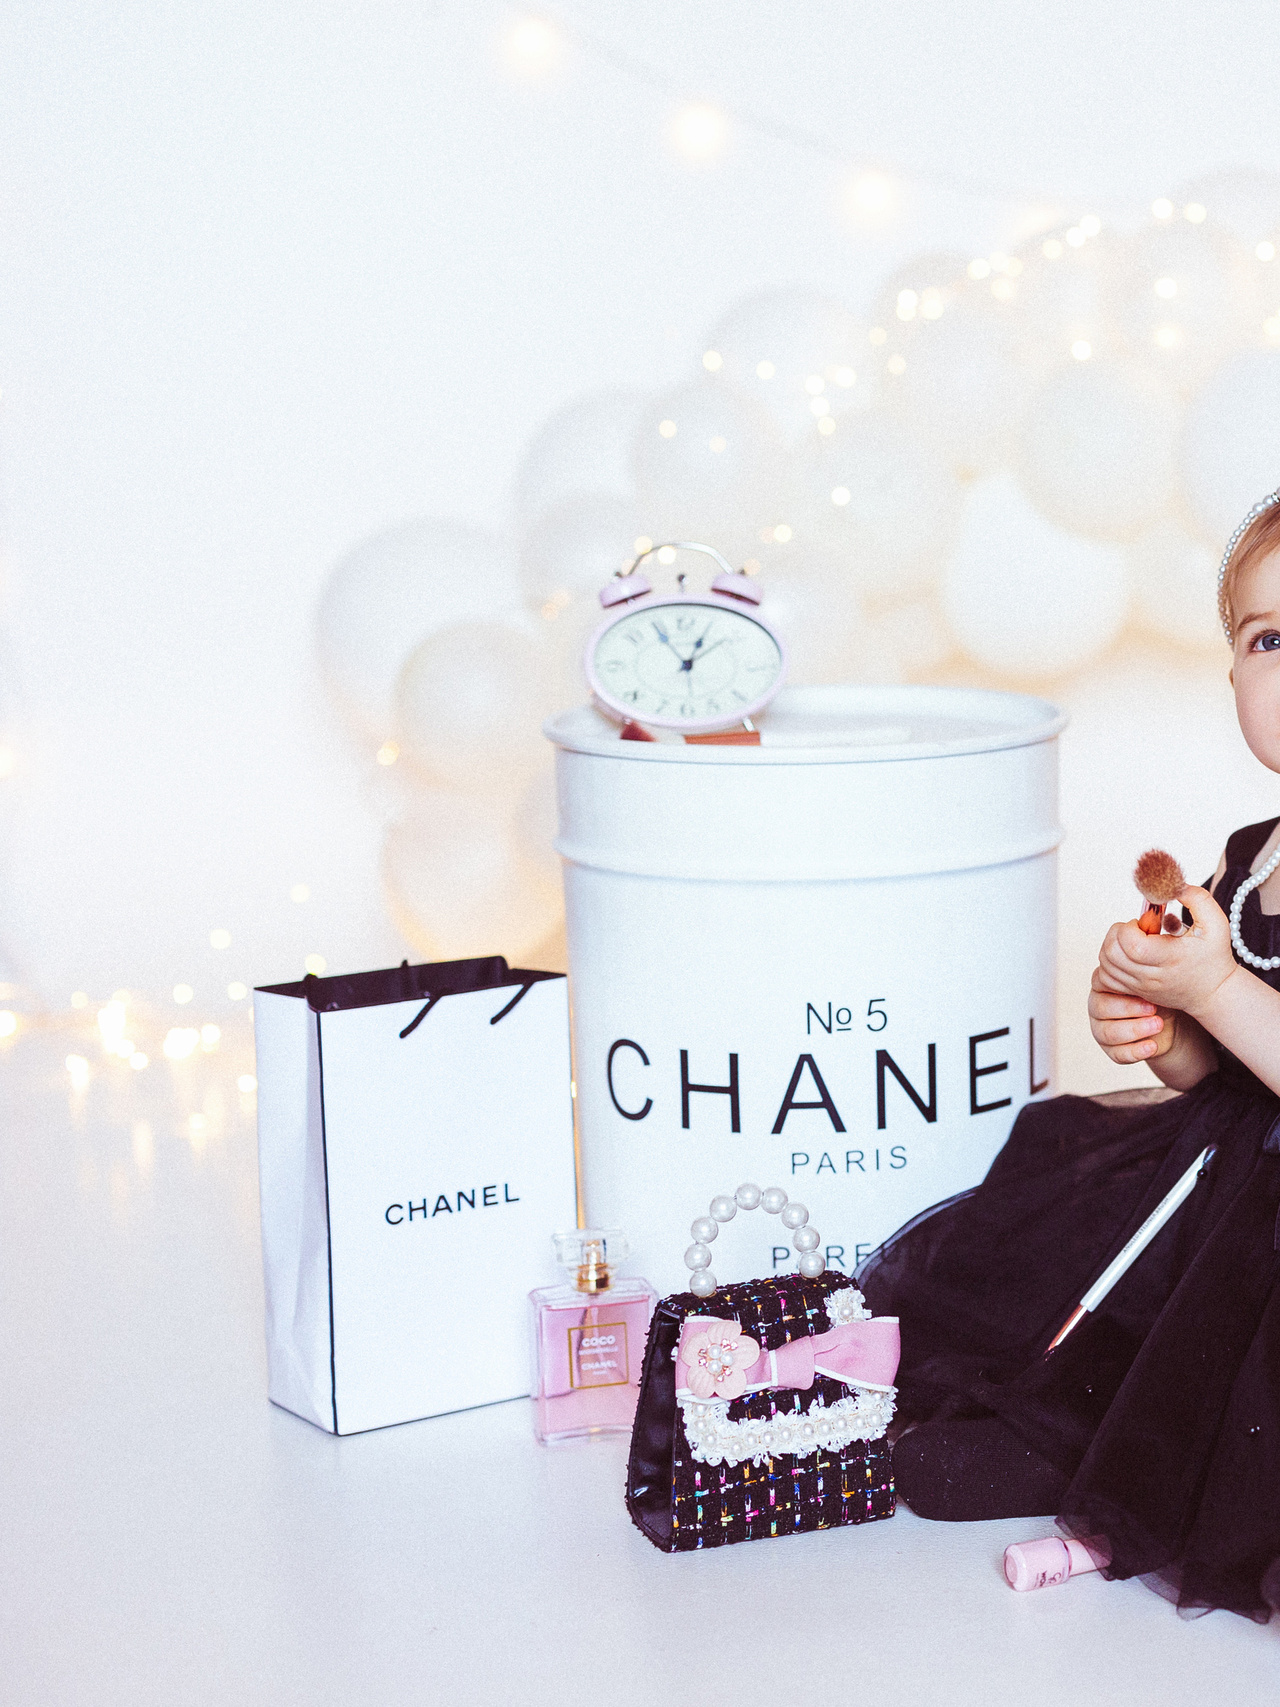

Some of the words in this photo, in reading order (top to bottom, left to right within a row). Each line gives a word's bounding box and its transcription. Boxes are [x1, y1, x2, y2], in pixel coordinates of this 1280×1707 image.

[866, 998, 888, 1032] 5
[606, 1017, 1049, 1134] CHANEL
[791, 1145, 908, 1175] PARIS
[385, 1183, 520, 1226] CHANEL
[581, 1334, 616, 1347] COCO
